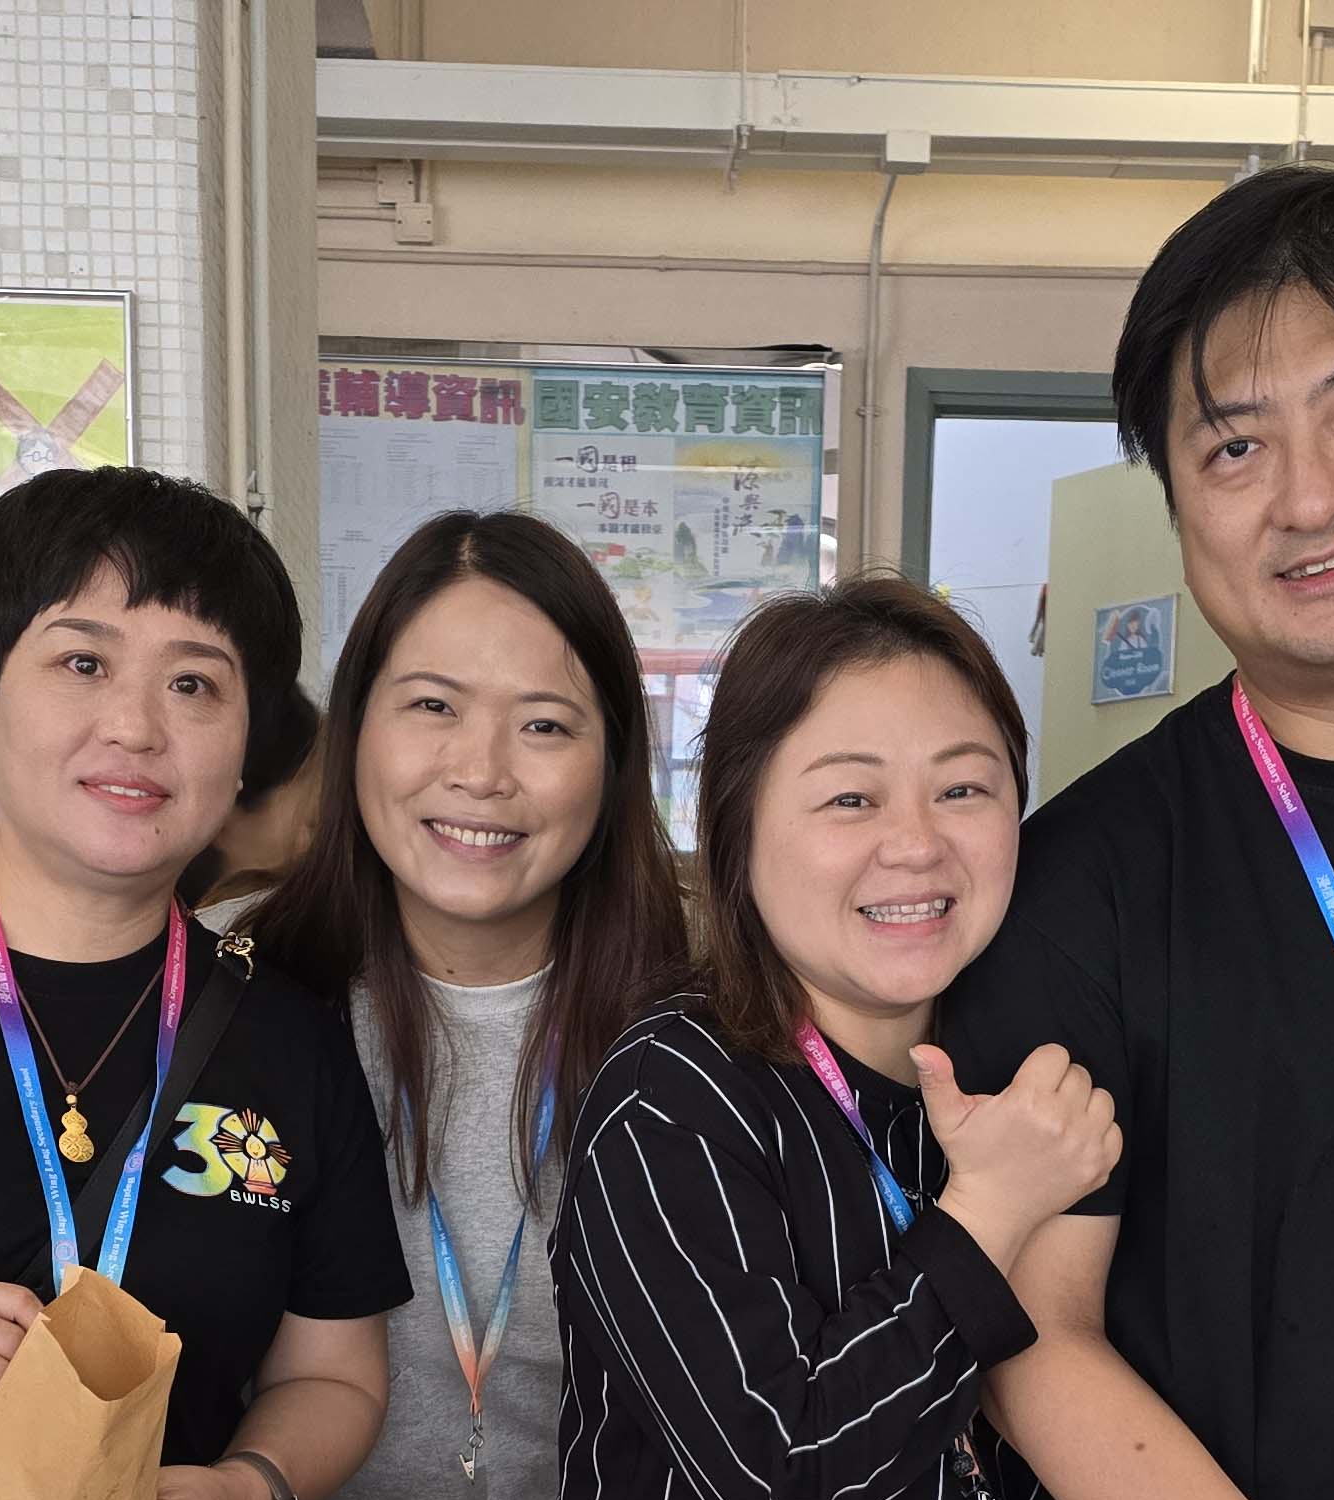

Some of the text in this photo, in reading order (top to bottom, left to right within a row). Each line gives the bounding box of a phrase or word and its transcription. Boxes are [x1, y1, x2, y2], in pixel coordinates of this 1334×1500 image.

[533, 379, 822, 436] 國安教育資訊
[1245, 715, 1259, 740] Lung
[1255, 737, 1281, 785] Secondary
[1276, 780, 1297, 813] School
[18, 1067, 35, 1098] School
[230, 1189, 292, 1214] BWLSS
